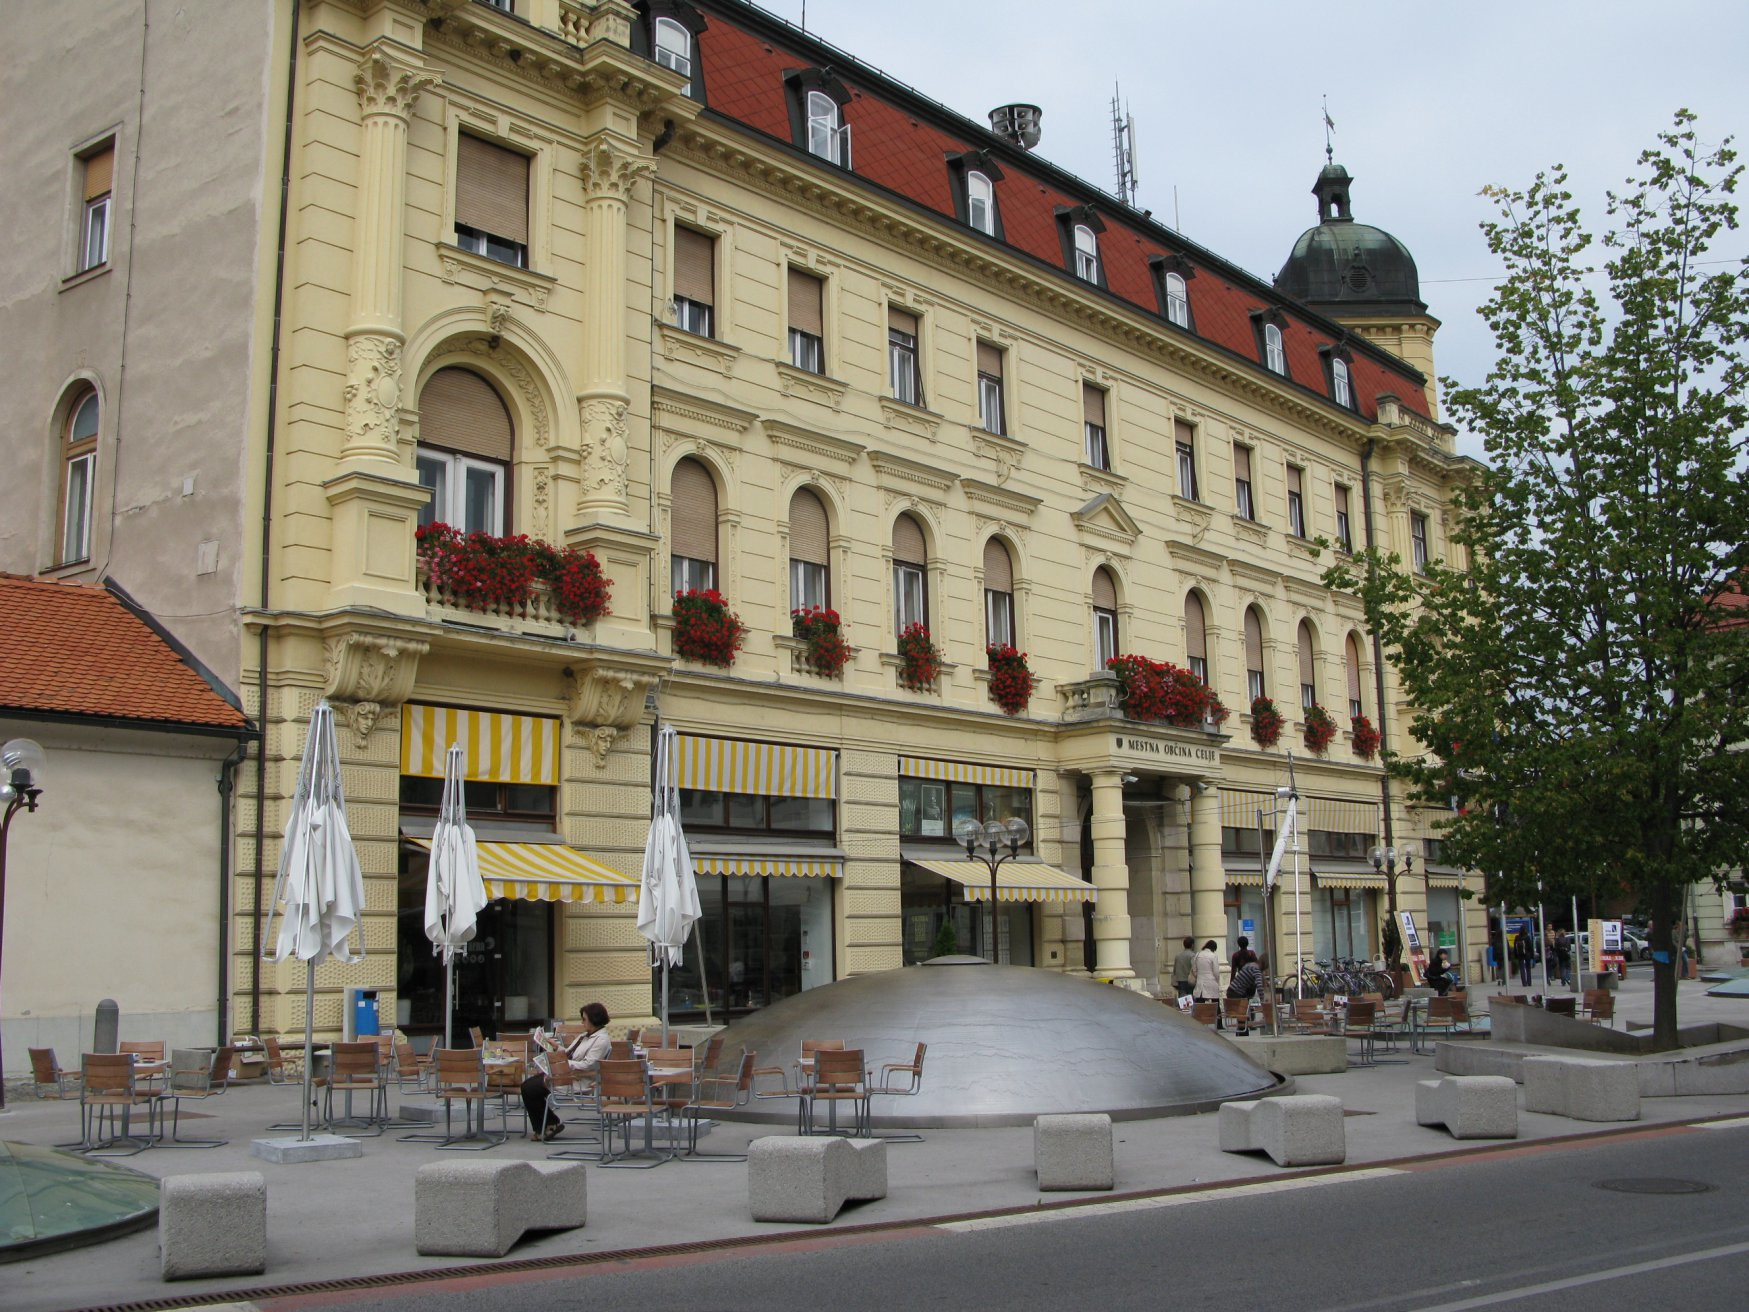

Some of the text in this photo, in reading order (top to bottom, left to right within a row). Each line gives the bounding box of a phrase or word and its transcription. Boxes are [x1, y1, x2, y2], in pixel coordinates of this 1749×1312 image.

[1128, 739, 1215, 761] MESTNA OBČINA CELJE
